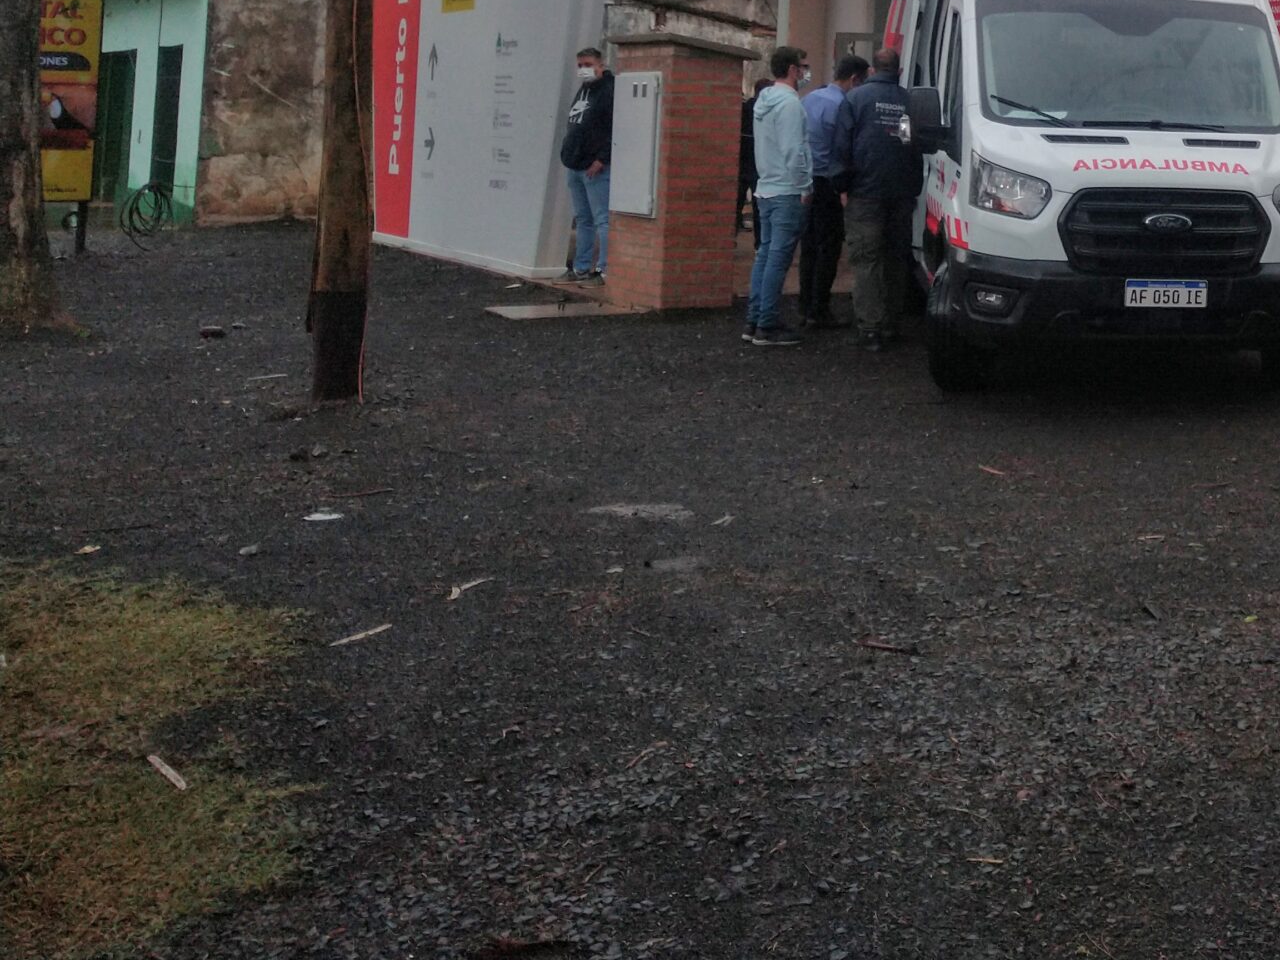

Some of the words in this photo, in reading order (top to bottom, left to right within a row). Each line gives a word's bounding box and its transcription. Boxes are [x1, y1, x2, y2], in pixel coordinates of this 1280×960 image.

[388, 17, 407, 175] Puerto
[1129, 289, 1148, 305] AF
[1152, 289, 1180, 305] 050
[1185, 290, 1203, 305] IE
